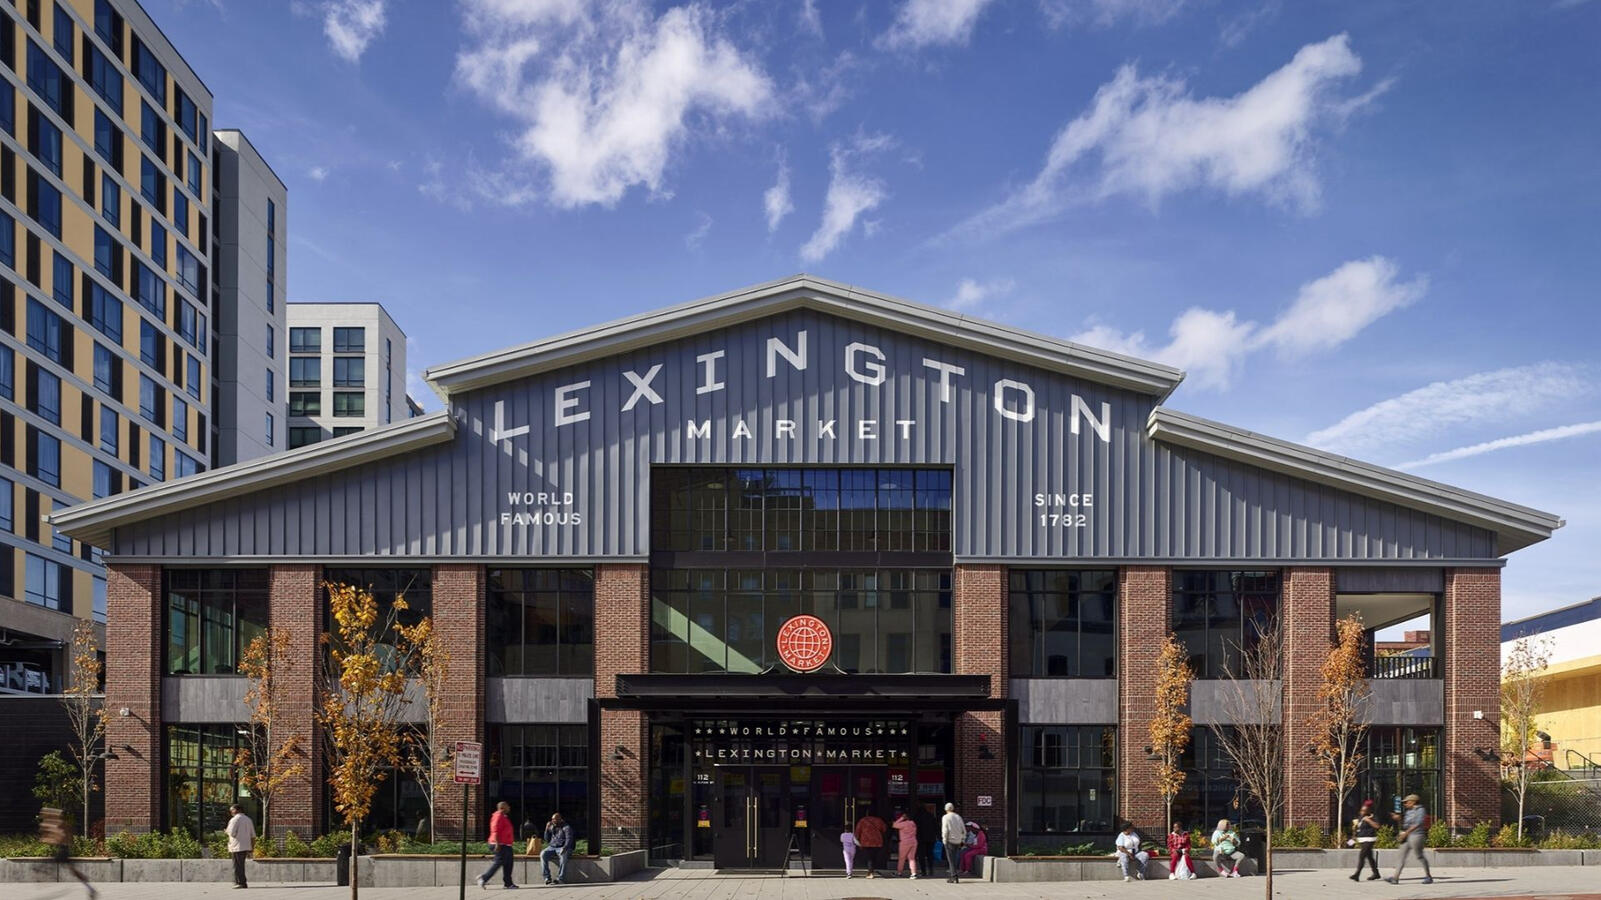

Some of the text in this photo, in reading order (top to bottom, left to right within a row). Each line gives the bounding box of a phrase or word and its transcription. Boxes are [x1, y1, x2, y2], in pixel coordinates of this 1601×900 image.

[494, 330, 1111, 443] LEXINGTON
[687, 420, 916, 440] MARKET
[507, 492, 574, 506] WORLD
[1034, 493, 1093, 507] SINCE
[500, 512, 582, 526] FAMOUS
[1040, 514, 1087, 528] 1782
[781, 618, 829, 645] LEXINGTON
[783, 650, 825, 667] MARKET
[729, 727, 874, 736] WORLD FAMOUS
[705, 749, 897, 759] LEXINGTON MARKET
